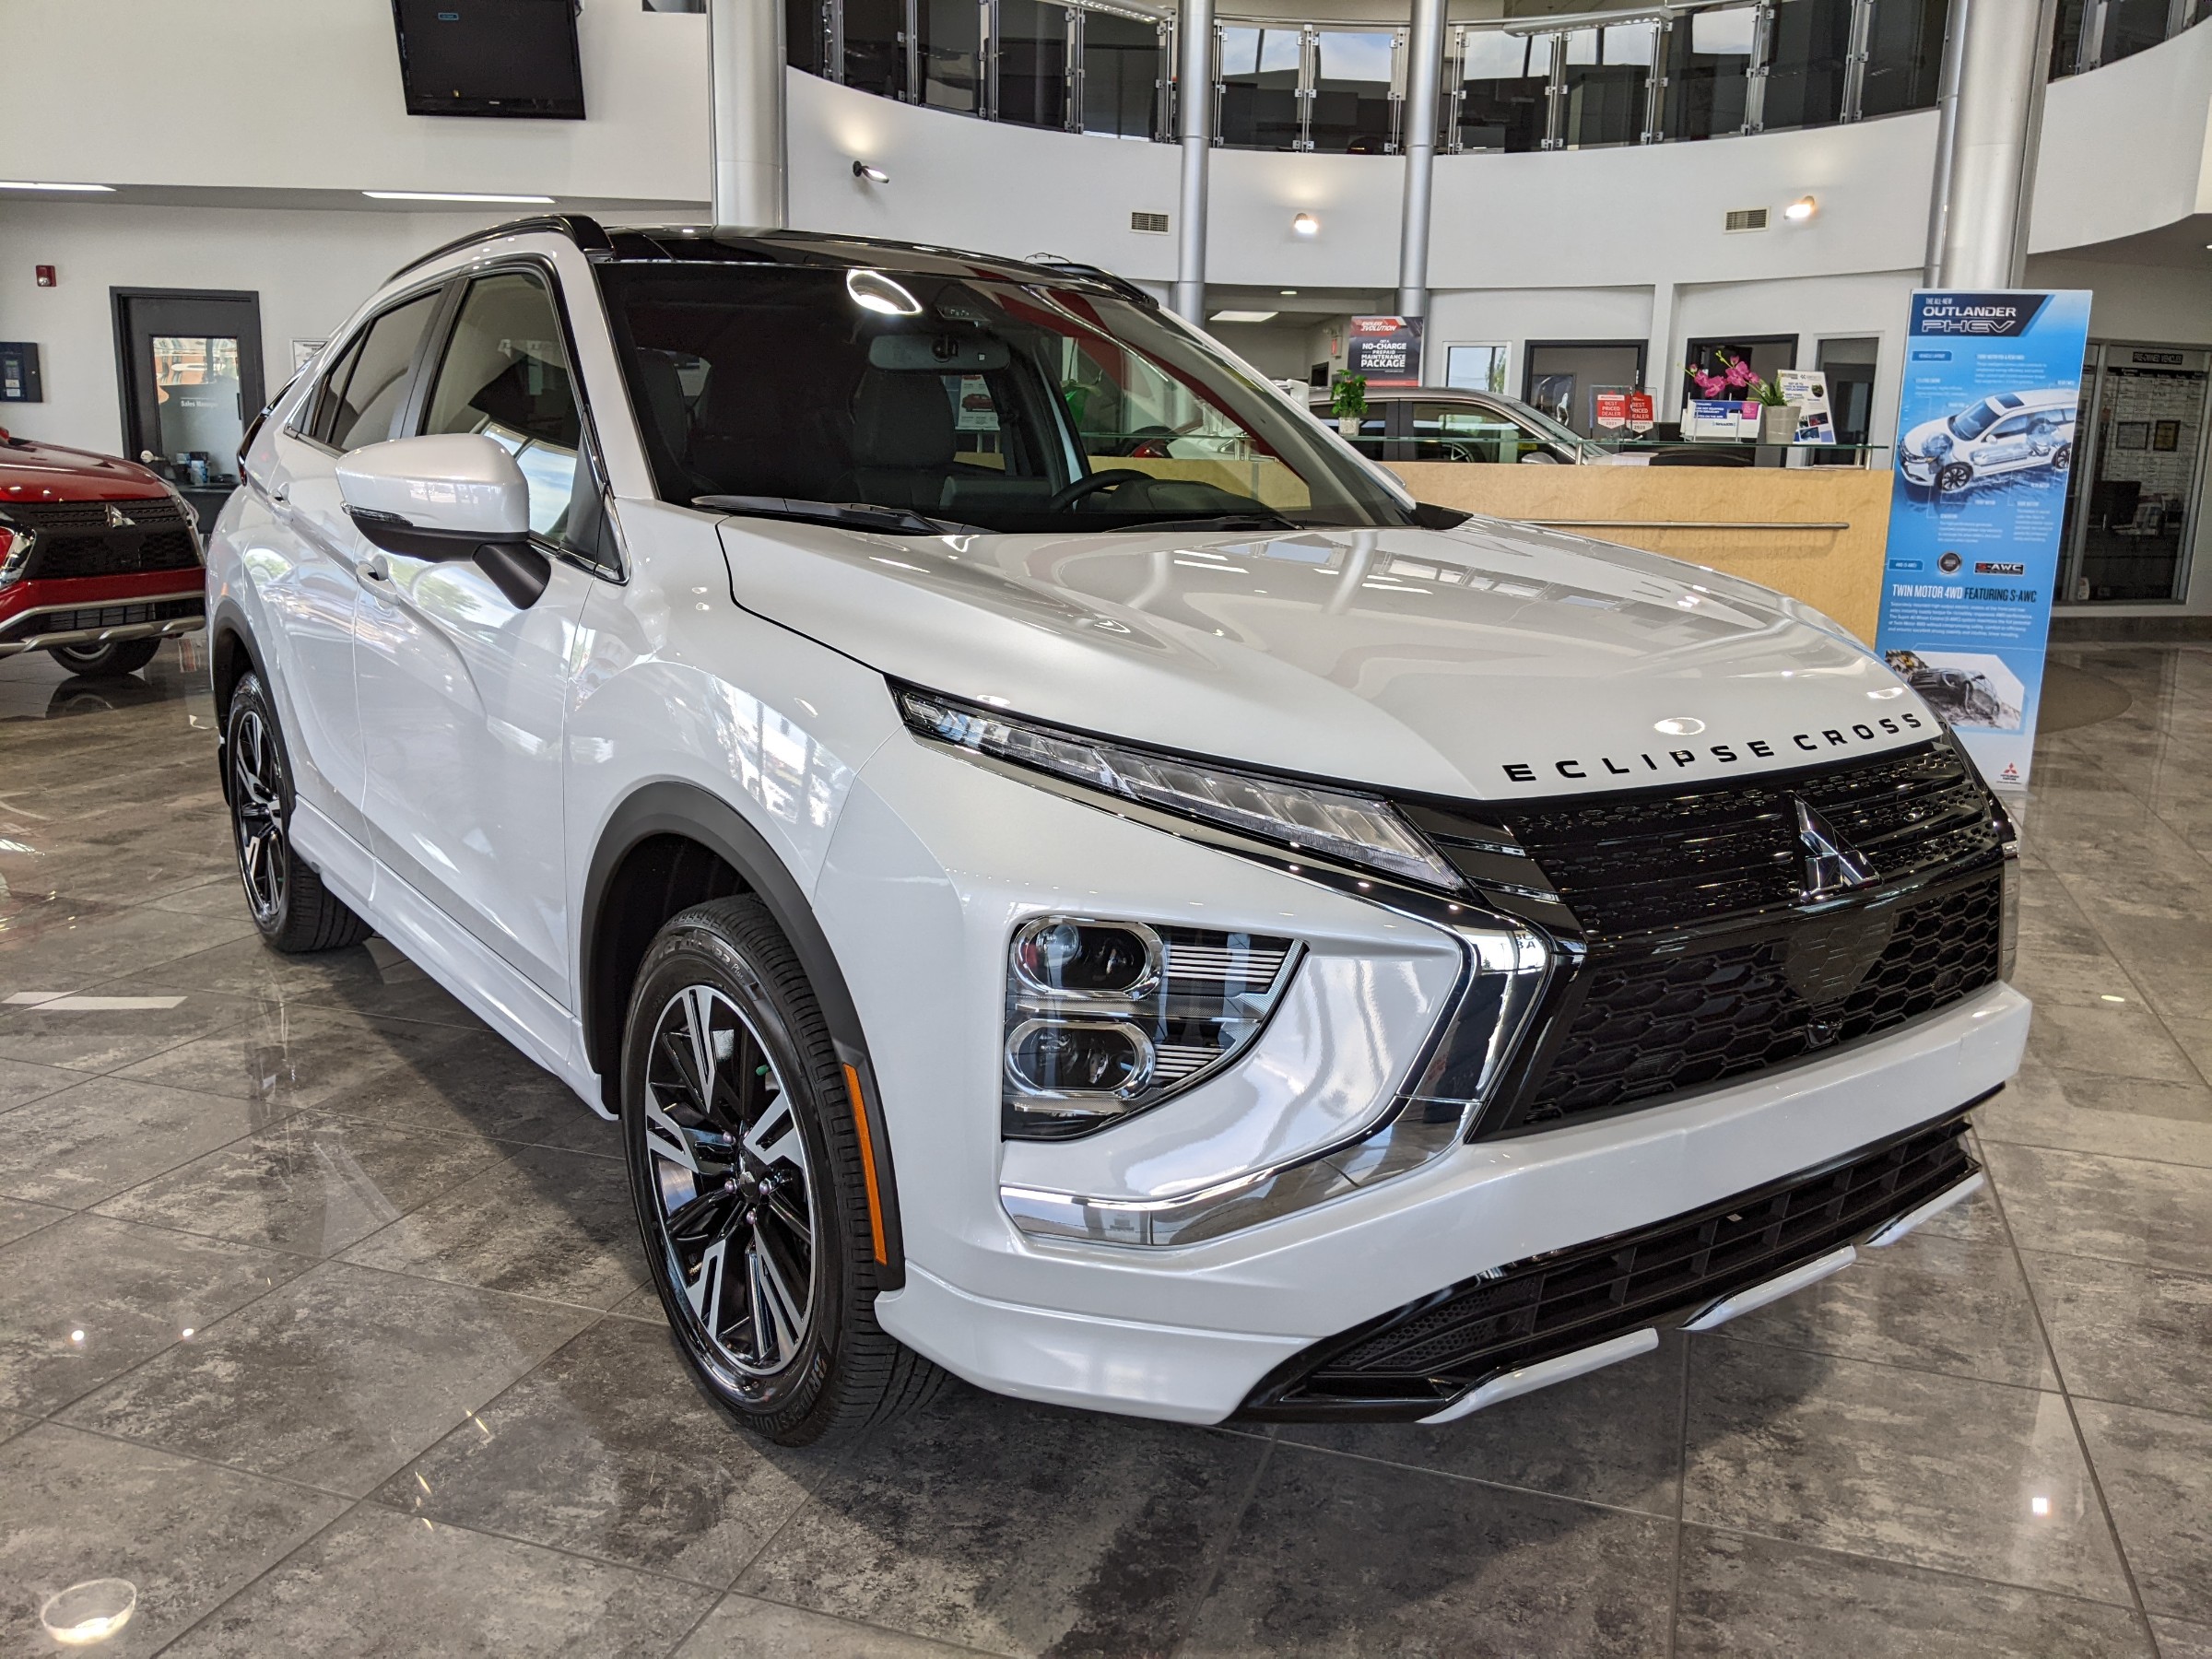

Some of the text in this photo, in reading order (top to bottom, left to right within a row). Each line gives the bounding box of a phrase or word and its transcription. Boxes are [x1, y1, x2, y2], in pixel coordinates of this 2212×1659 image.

[1923, 306, 2017, 317] OUTLANDER
[1922, 320, 2016, 333] PHEV
[1362, 342, 1407, 350] NO-CHARGE
[1360, 359, 1406, 368] PACKAGE
[1978, 563, 2022, 571] S-AWC
[1892, 584, 2038, 603] TWIN MOTOR 4WD FEATURING S-AWC
[1501, 712, 1923, 782] ECLIPSE CROSS
